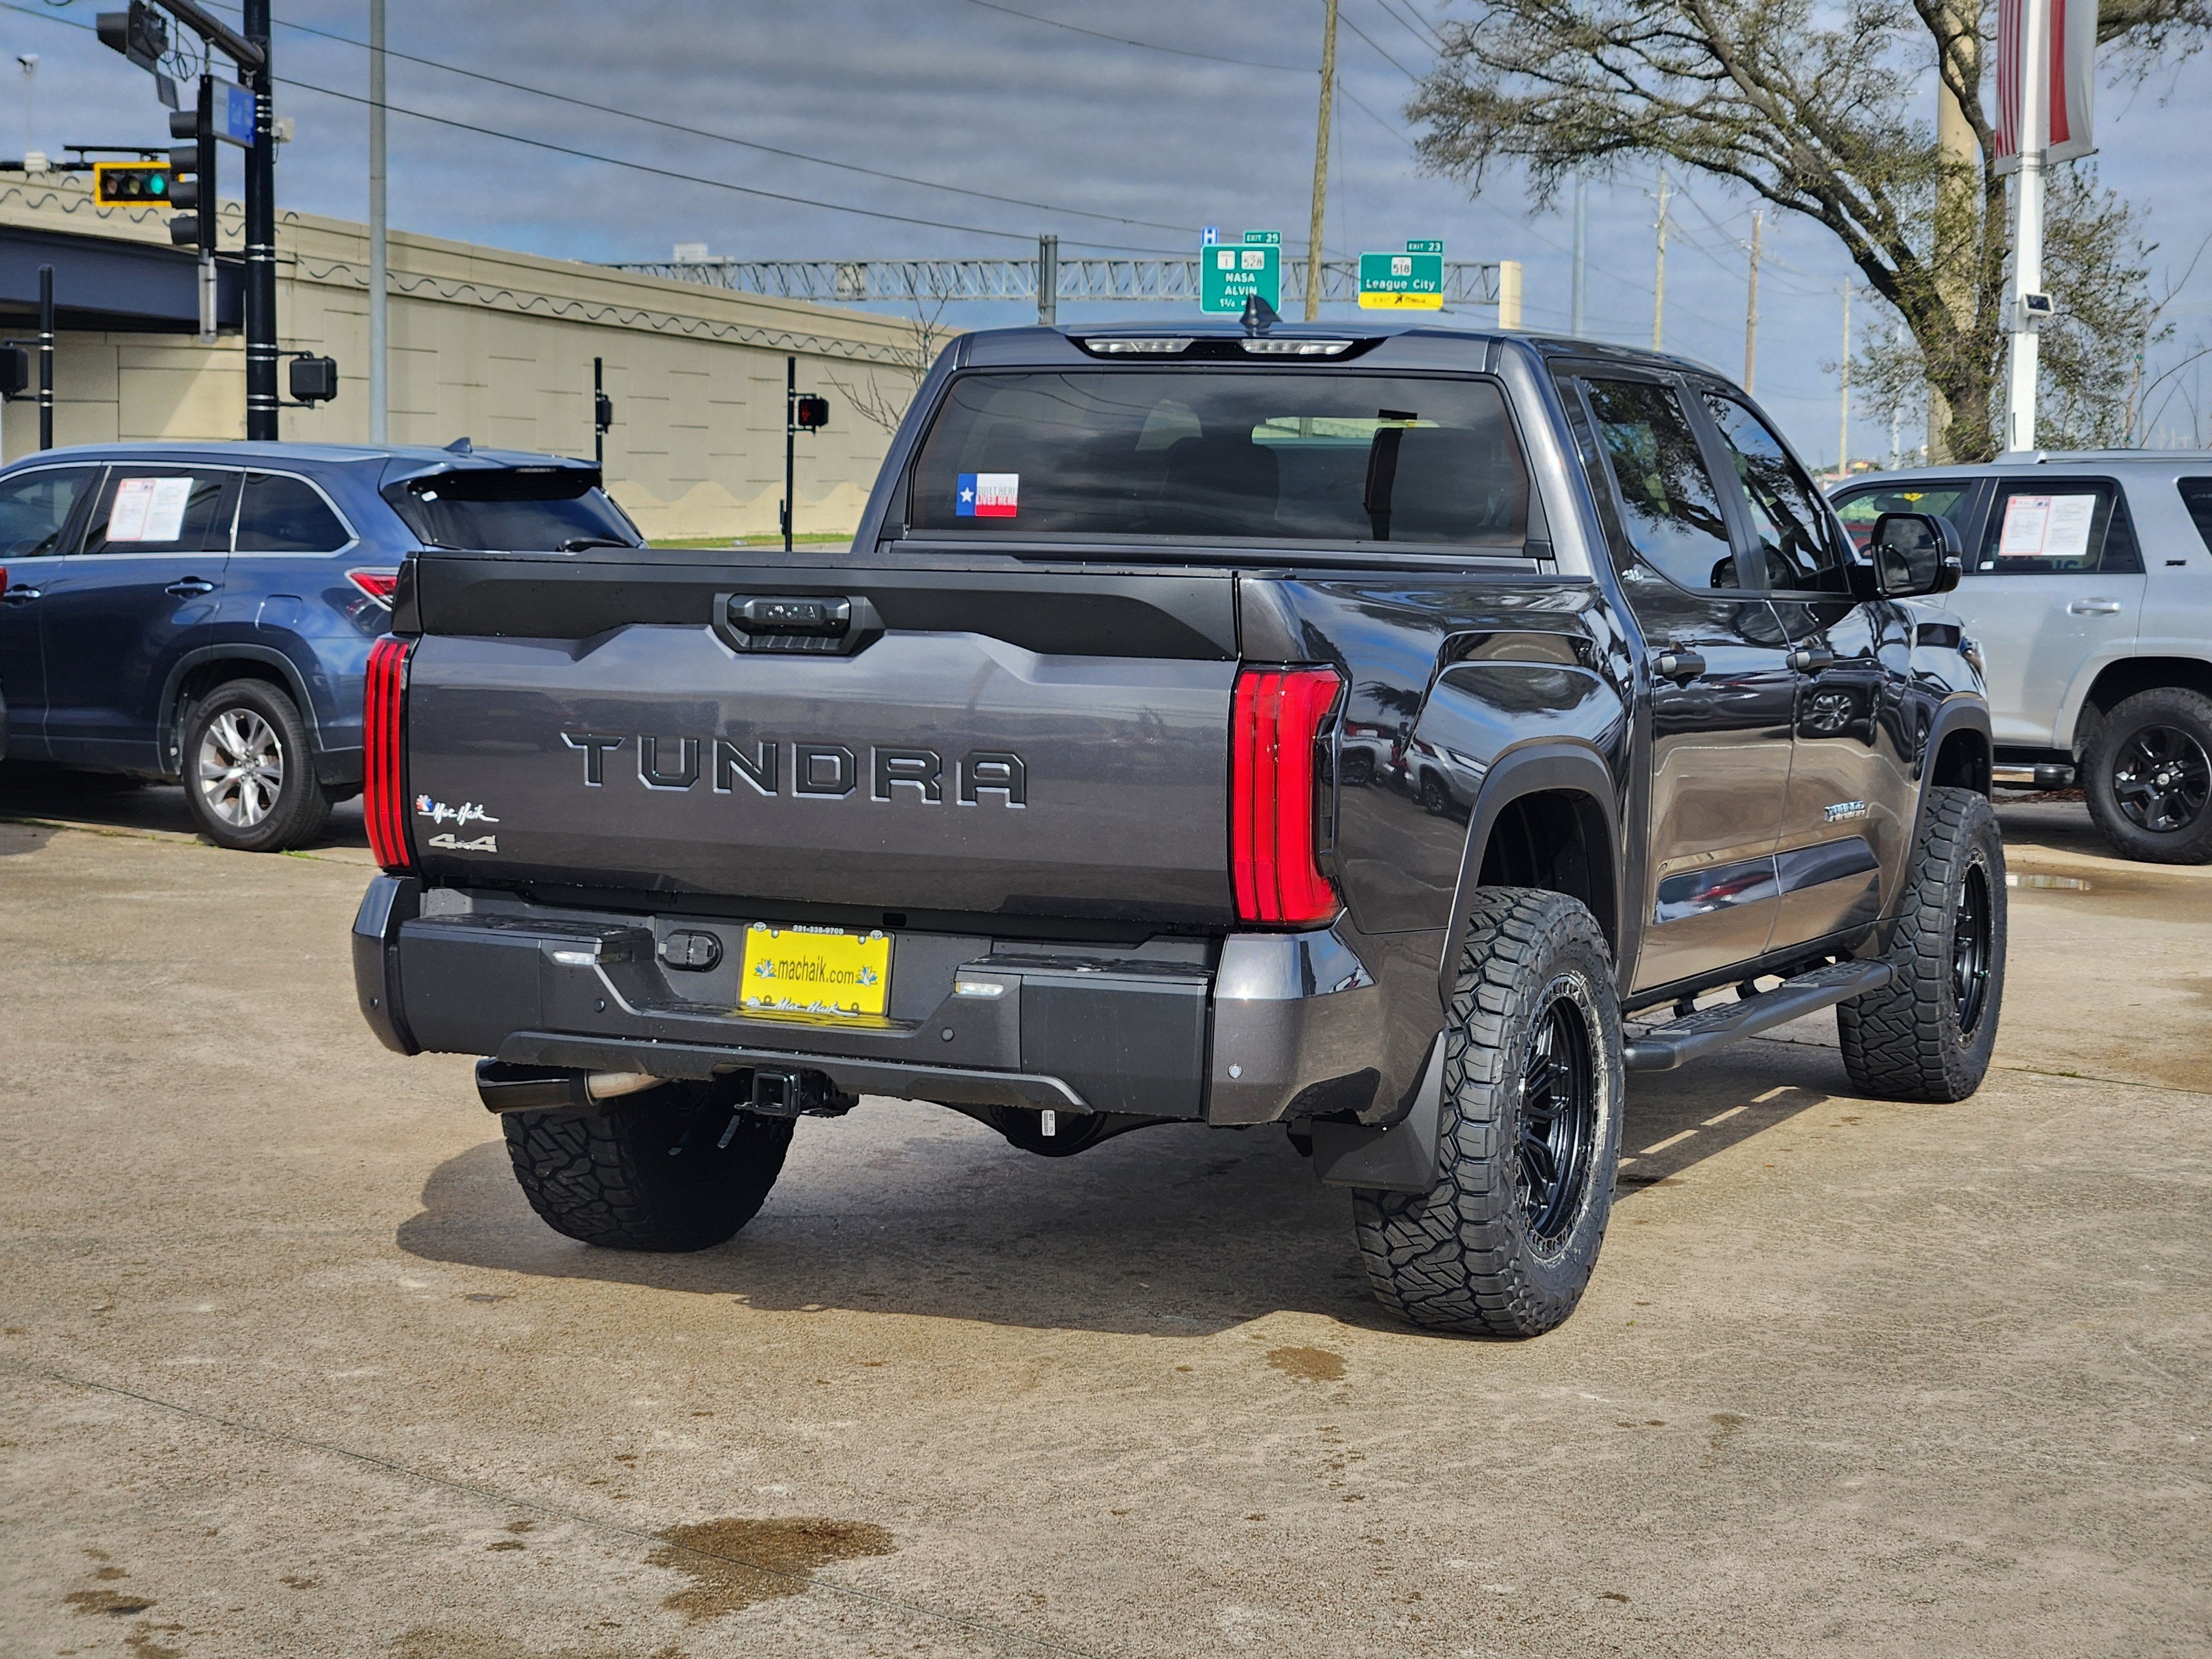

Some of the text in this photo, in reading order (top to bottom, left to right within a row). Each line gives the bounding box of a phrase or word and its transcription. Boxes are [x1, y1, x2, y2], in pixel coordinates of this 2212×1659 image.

[1428, 242, 1441, 252] 23
[1392, 264, 1410, 274] 518
[1225, 272, 1255, 283] NASA
[1224, 285, 1258, 295] ALVIN
[1365, 279, 1436, 292] League City
[999, 487, 1018, 495] HERE
[977, 495, 1018, 505] LIVES HERE
[560, 731, 1027, 808] TUNDRA
[429, 802, 493, 826] Mac Haik
[778, 954, 854, 984] machaik.com
[773, 997, 804, 1010] Mac
